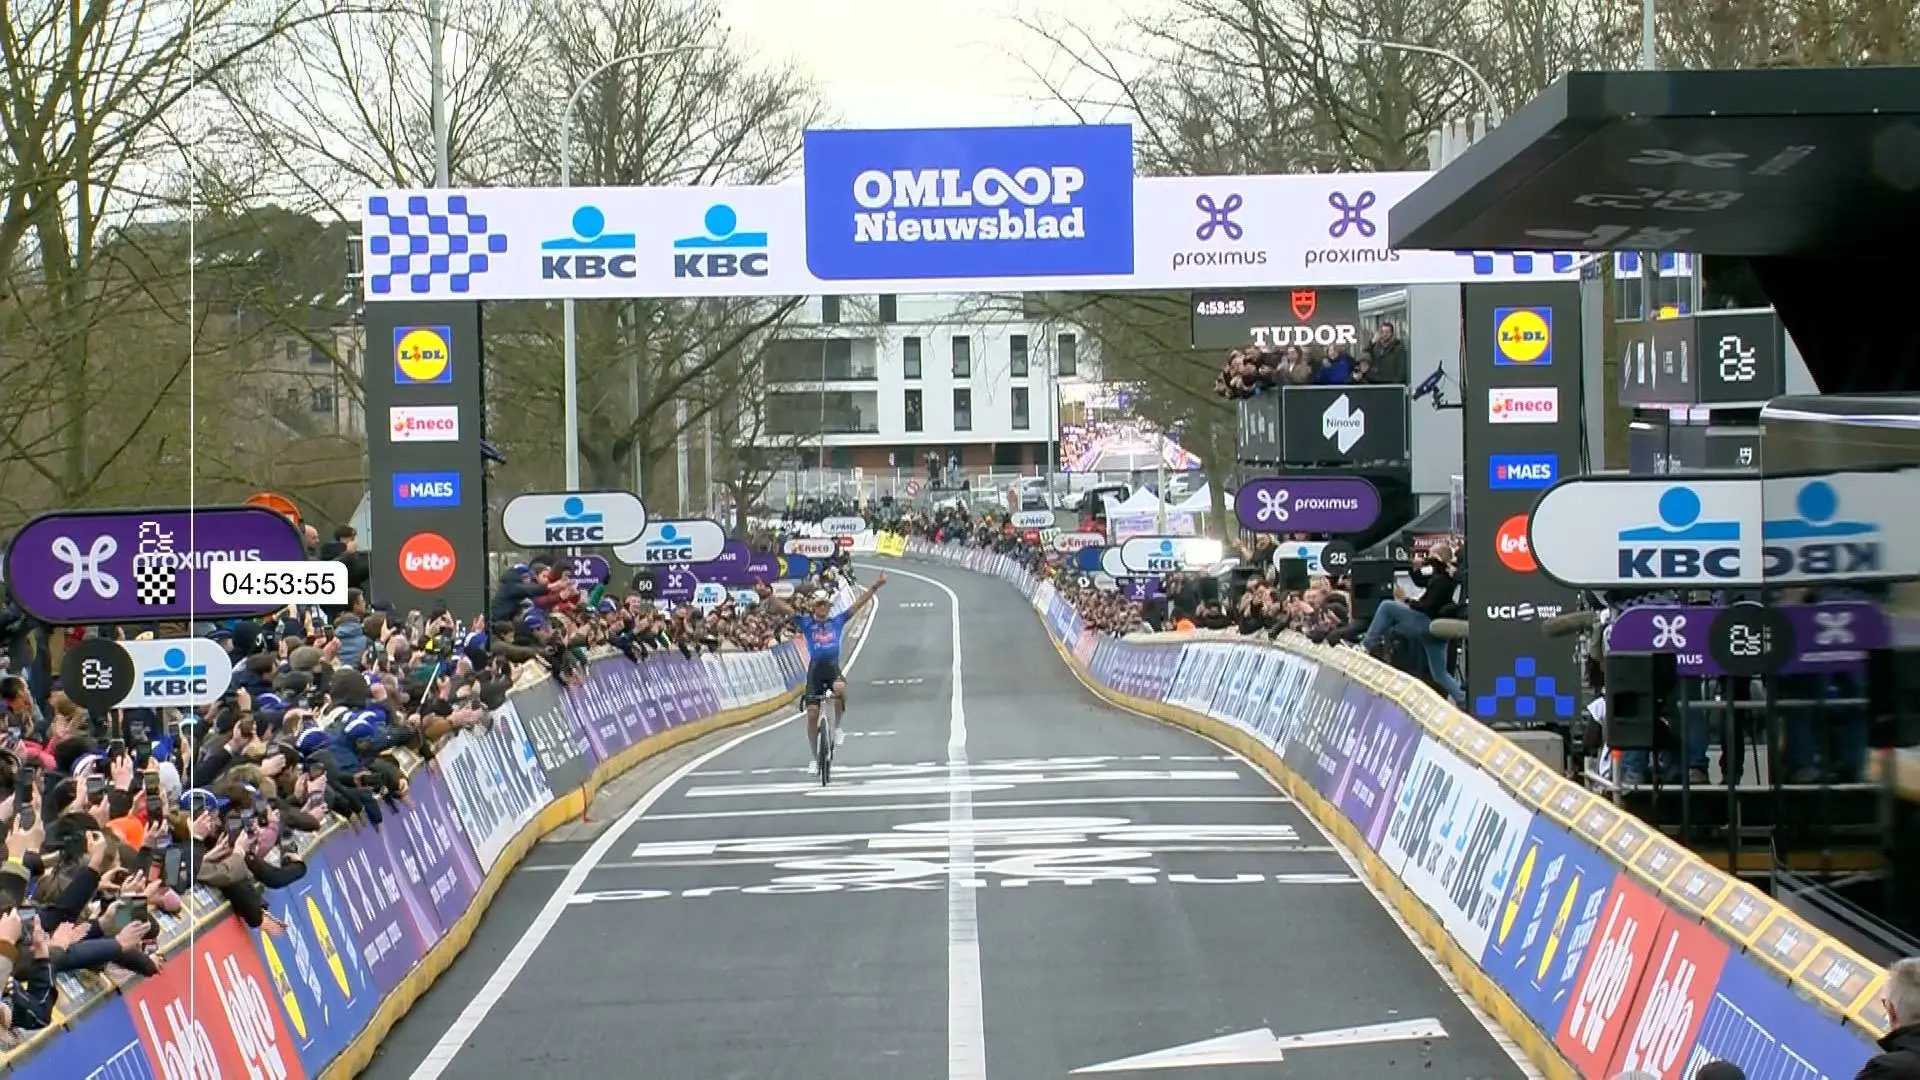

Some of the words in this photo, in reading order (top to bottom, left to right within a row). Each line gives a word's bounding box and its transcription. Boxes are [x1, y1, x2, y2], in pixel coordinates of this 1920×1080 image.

[853, 166, 1085, 208] OMLOOP
[853, 207, 1085, 242] Nieuwsblad
[541, 254, 637, 280] KBC
[674, 252, 769, 278] KBC
[1173, 250, 1267, 270] proximus
[1305, 248, 1400, 268] proximus
[1196, 300, 1245, 315] 4:53:55
[1250, 324, 1358, 346] TUDOR
[1504, 399, 1553, 411] Eneco
[406, 417, 454, 430] Eneco
[1508, 464, 1551, 478] MAES
[411, 482, 454, 497] MAES
[1295, 497, 1359, 511] proximus
[545, 526, 605, 542] KBC
[133, 549, 261, 578] proximus
[646, 547, 692, 561] KBC
[1329, 552, 1347, 565] 25
[1619, 547, 1741, 578] KBC
[1487, 605, 1516, 619] UCI
[144, 679, 207, 696] KBC
[1399, 760, 1455, 868] KBC
[1449, 802, 1508, 922] KBC
[565, 871, 1363, 904] proximus
